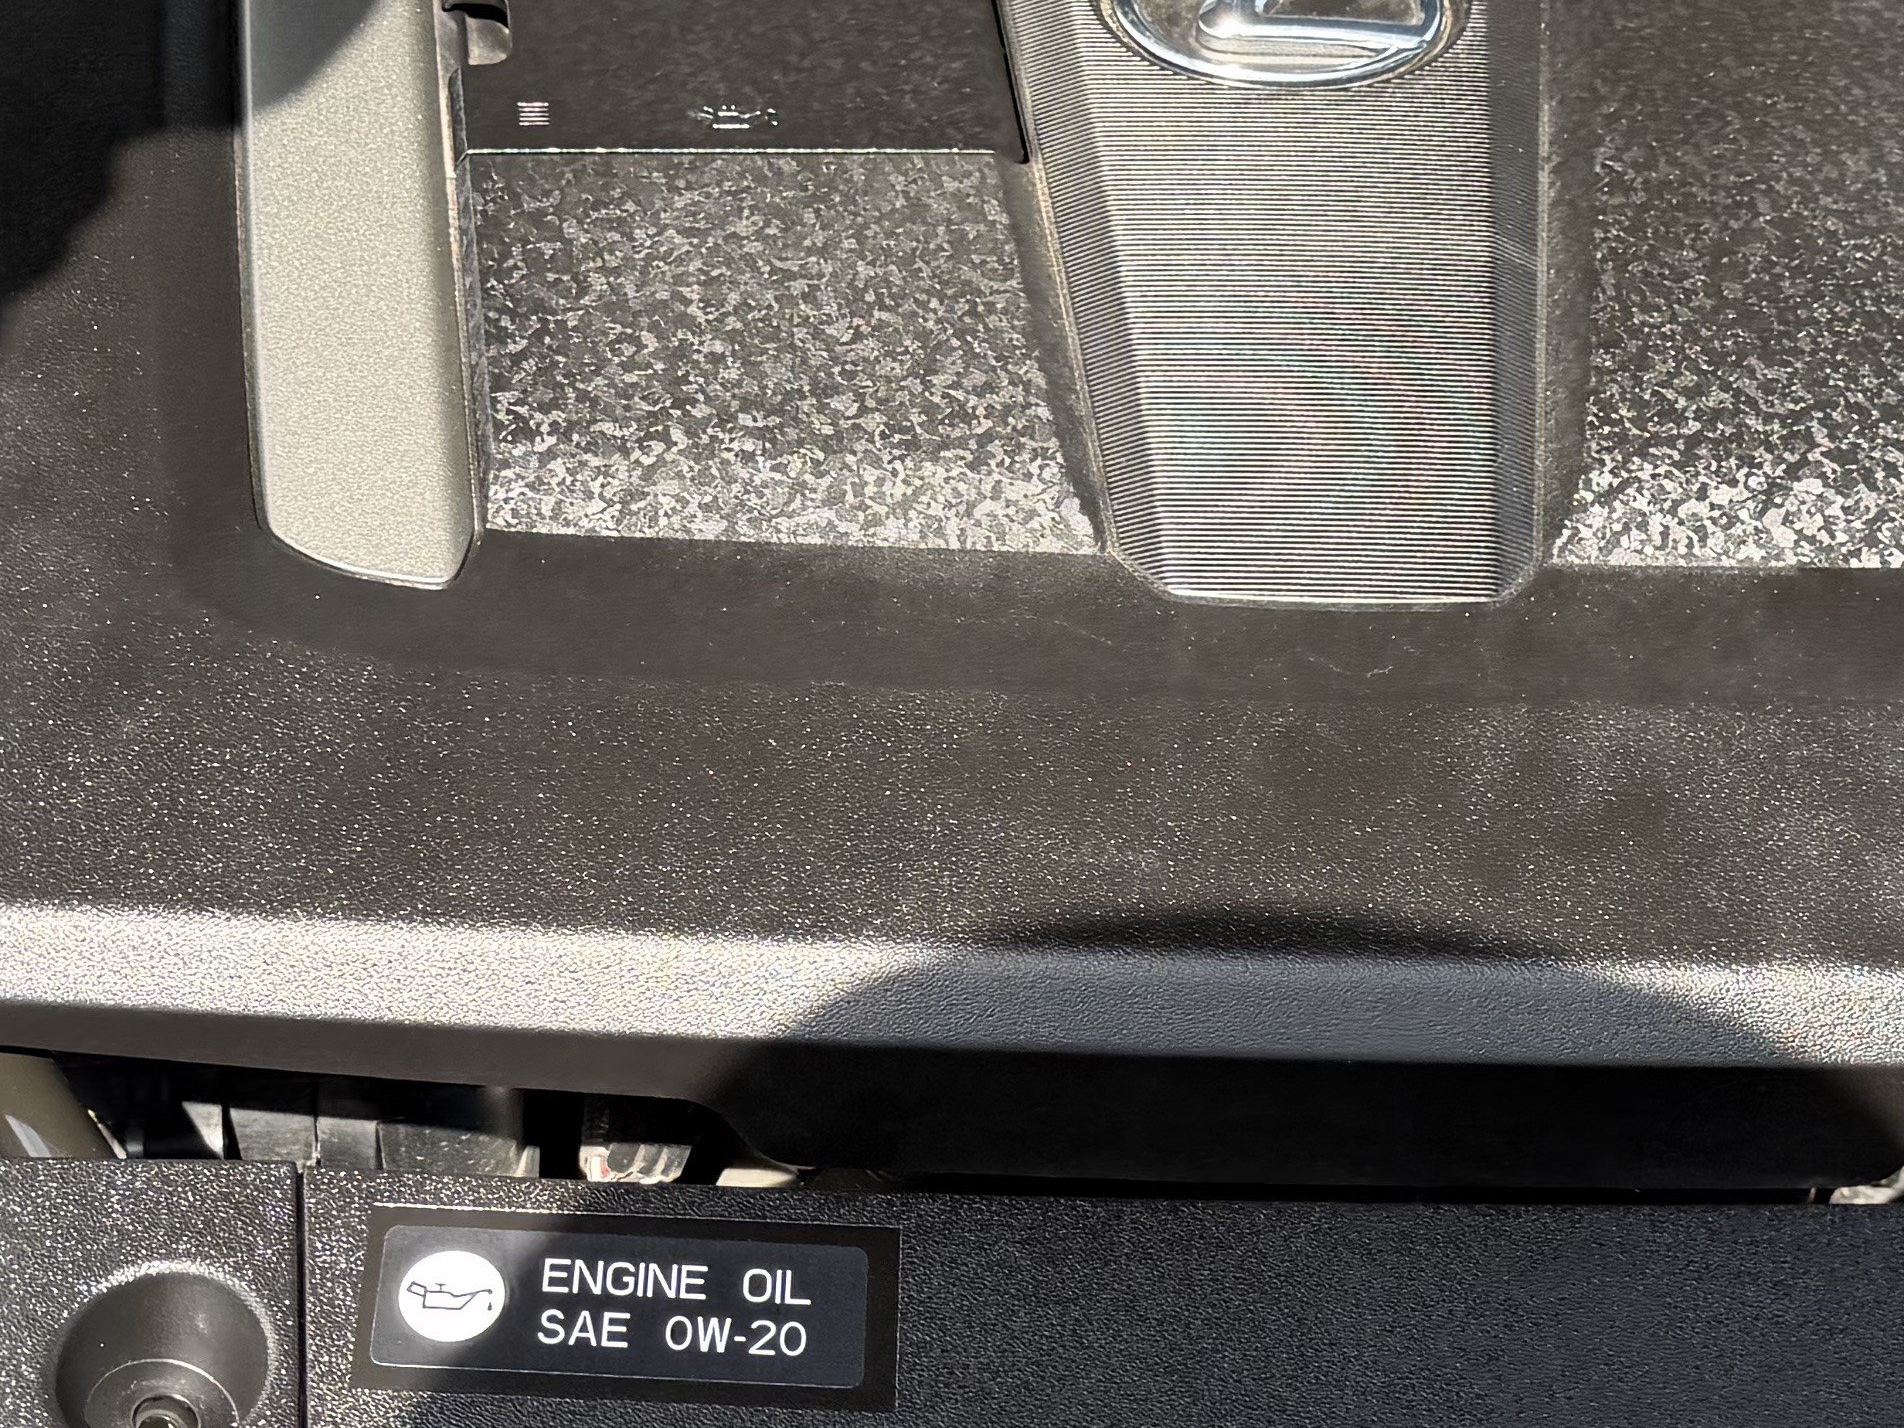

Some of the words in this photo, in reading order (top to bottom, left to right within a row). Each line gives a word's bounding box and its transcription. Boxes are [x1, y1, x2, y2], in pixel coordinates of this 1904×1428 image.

[540, 1257, 708, 1302] ENGINE
[741, 1268, 812, 1306] OIL
[536, 1309, 631, 1349] SAE
[664, 1315, 808, 1358] 0W-20
